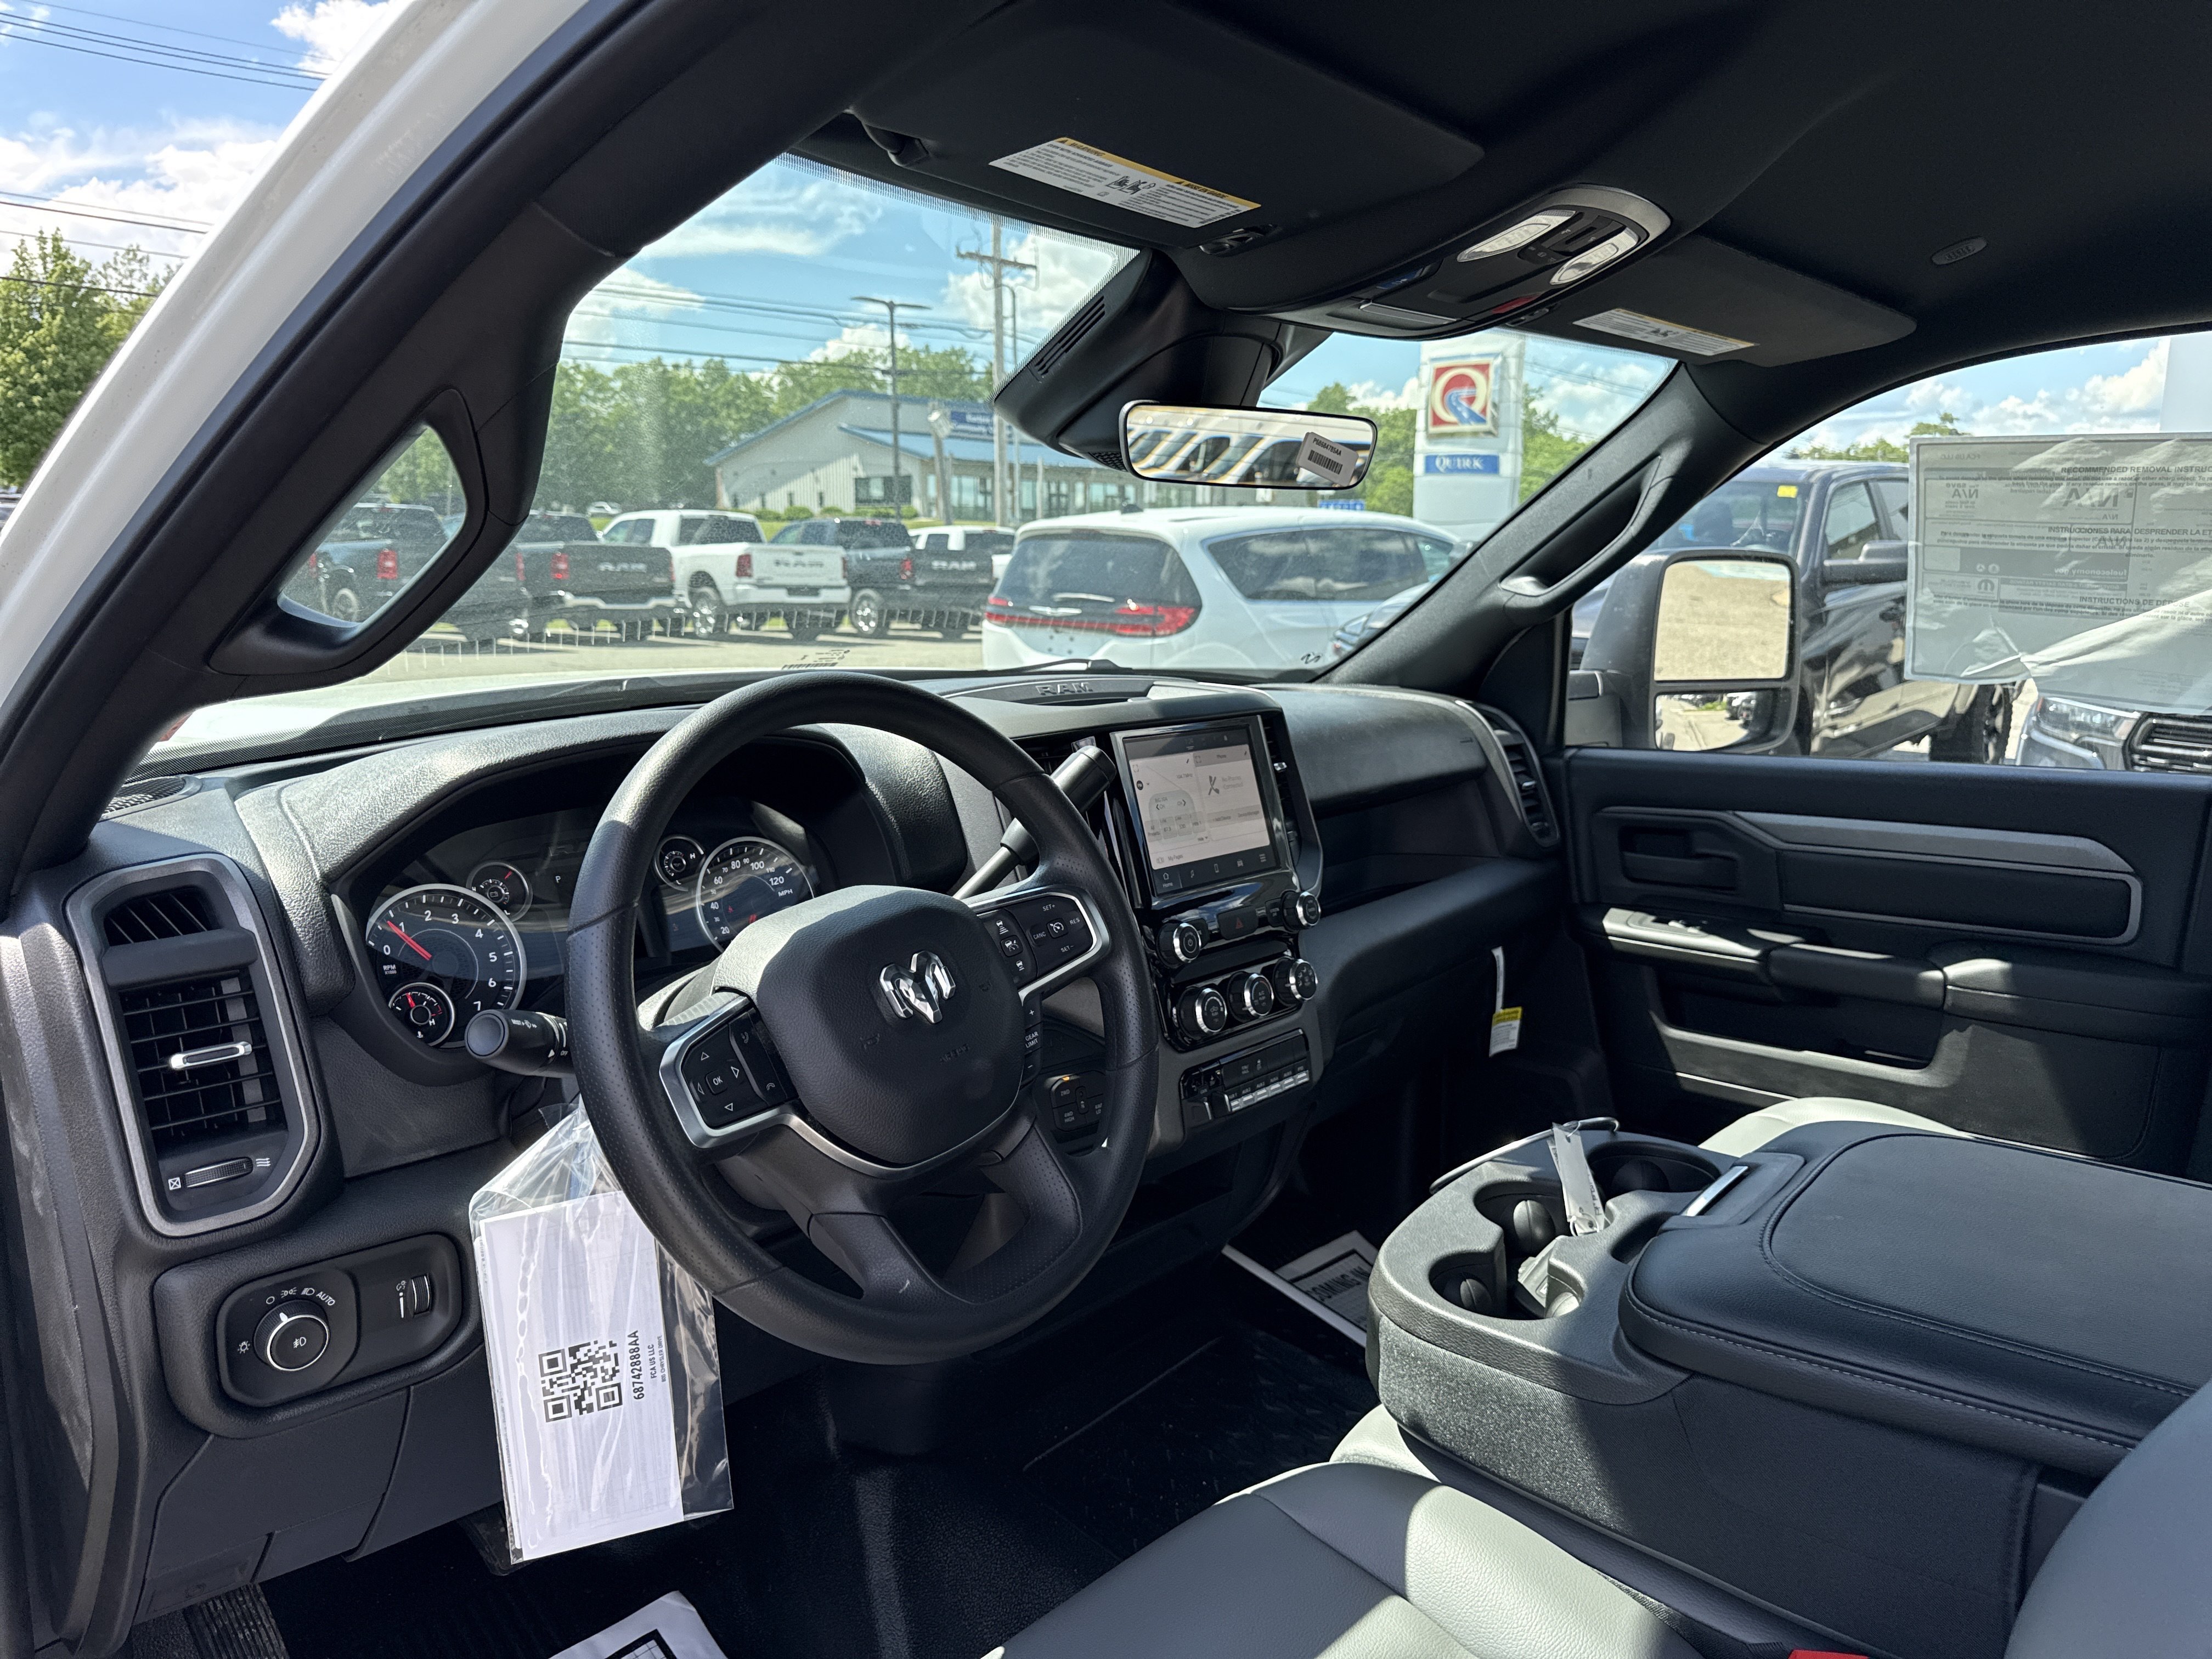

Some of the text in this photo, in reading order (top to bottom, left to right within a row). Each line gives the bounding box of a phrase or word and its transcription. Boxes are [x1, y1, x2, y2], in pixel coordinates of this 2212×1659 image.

[1435, 455, 1483, 473] QUIRK
[2048, 526, 2109, 534] INSTRUCCIONES
[597, 561, 647, 573] RAM
[932, 560, 977, 571] RAM
[2079, 596, 2140, 606] INSTRUCTIONS
[1035, 682, 1093, 696] RAM
[731, 860, 741, 870] 80
[750, 860, 765, 871] 100
[555, 875, 561, 883] P
[714, 876, 723, 885] 60
[769, 876, 785, 887] 120
[777, 888, 793, 898] MPH
[710, 901, 719, 910] 40
[424, 910, 432, 922] 2
[452, 913, 460, 924] 3
[399, 922, 405, 933] 1
[720, 926, 730, 935] 20
[475, 928, 484, 939] 4
[1033, 931, 1046, 940] CANC
[383, 944, 391, 956] 0
[488, 952, 498, 962] 5
[488, 978, 496, 987] 6
[473, 1000, 482, 1011] 7
[1025, 1031, 1039, 1041] GEAR
[1025, 1038, 1038, 1048] LIMIT
[713, 1075, 723, 1086] OK
[315, 1291, 335, 1306] AUTO
[627, 1330, 645, 1400] 68742888AA
[649, 1357, 656, 1367] US
